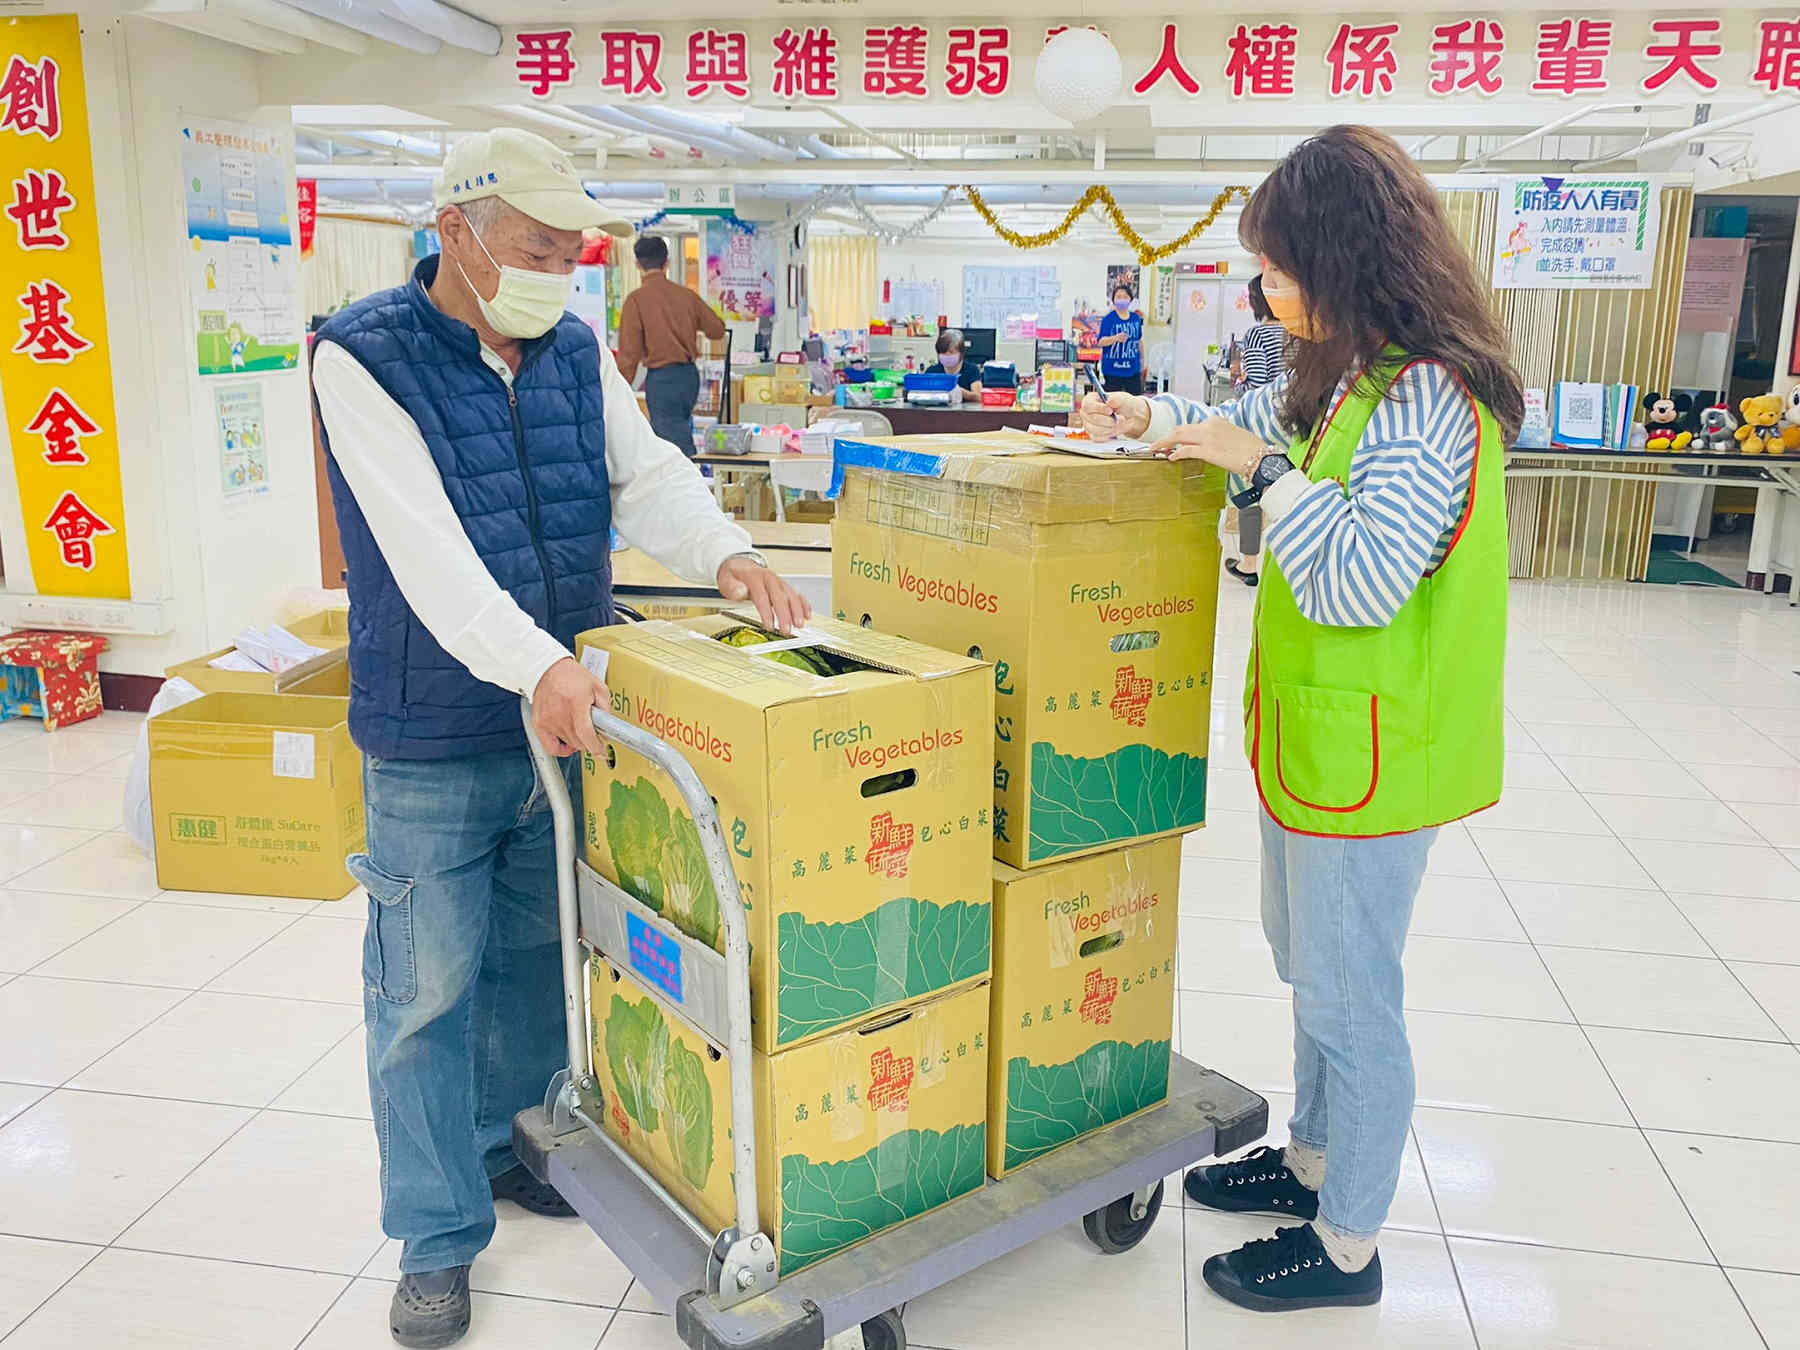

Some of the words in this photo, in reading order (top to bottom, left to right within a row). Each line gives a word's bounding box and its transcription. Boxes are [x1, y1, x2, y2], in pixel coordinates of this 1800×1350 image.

[516, 21, 1800, 97] 爭取與維護弱人權係我輩天職
[1522, 189, 1640, 211] 防疫人人有責
[1, 58, 114, 568] 創世基金會
[850, 552, 891, 584] Fresh
[897, 564, 998, 614] Vegetables
[1071, 580, 1121, 603] Fresh
[1097, 597, 1195, 626] Vegetables
[1157, 671, 1209, 697] 包心白菜
[636, 695, 732, 763] Vegetables
[812, 720, 872, 752] Fresh
[844, 728, 964, 769] Vegetables
[993, 659, 1014, 843] 包心白菜
[921, 808, 988, 843] 包心白菜
[792, 845, 857, 880] 高麗菜
[1044, 891, 1090, 920] Fresh
[1069, 893, 1159, 933] Vegetables
